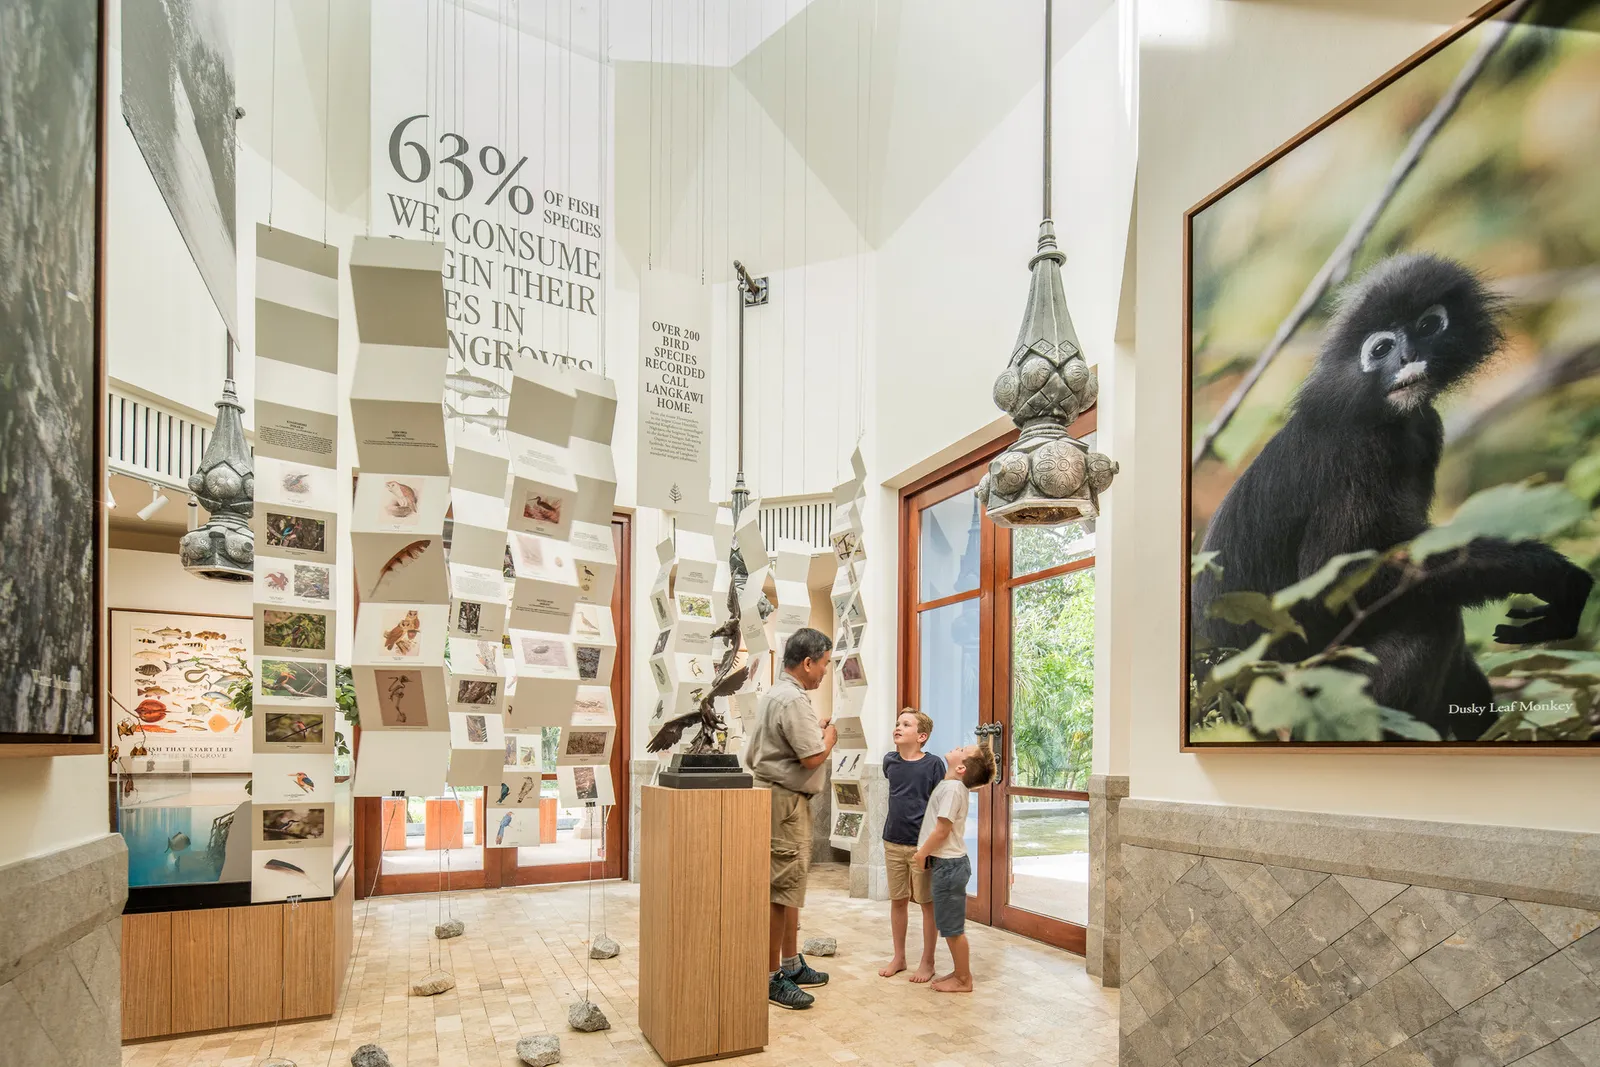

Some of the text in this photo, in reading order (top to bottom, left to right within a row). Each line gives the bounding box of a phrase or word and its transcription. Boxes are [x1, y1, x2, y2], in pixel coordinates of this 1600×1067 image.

[388, 114, 535, 216] 63%
[544, 189, 600, 220] OF FISH
[387, 192, 602, 280] WE CONSUME
[543, 209, 602, 239] SPECIES
[441, 247, 494, 290] GIN
[503, 263, 597, 316] THEIR
[491, 299, 526, 336] IN
[652, 320, 700, 342] OVER 200
[662, 335, 690, 351] BIRD
[645, 356, 706, 380] RECORDED
[653, 346, 697, 366] SPECIES
[646, 381, 703, 405] LANGKAWI
[661, 373, 689, 389] CALL
[656, 397, 693, 414] HOME.
[1448, 700, 1573, 716] Dusky Leaf Monkey
